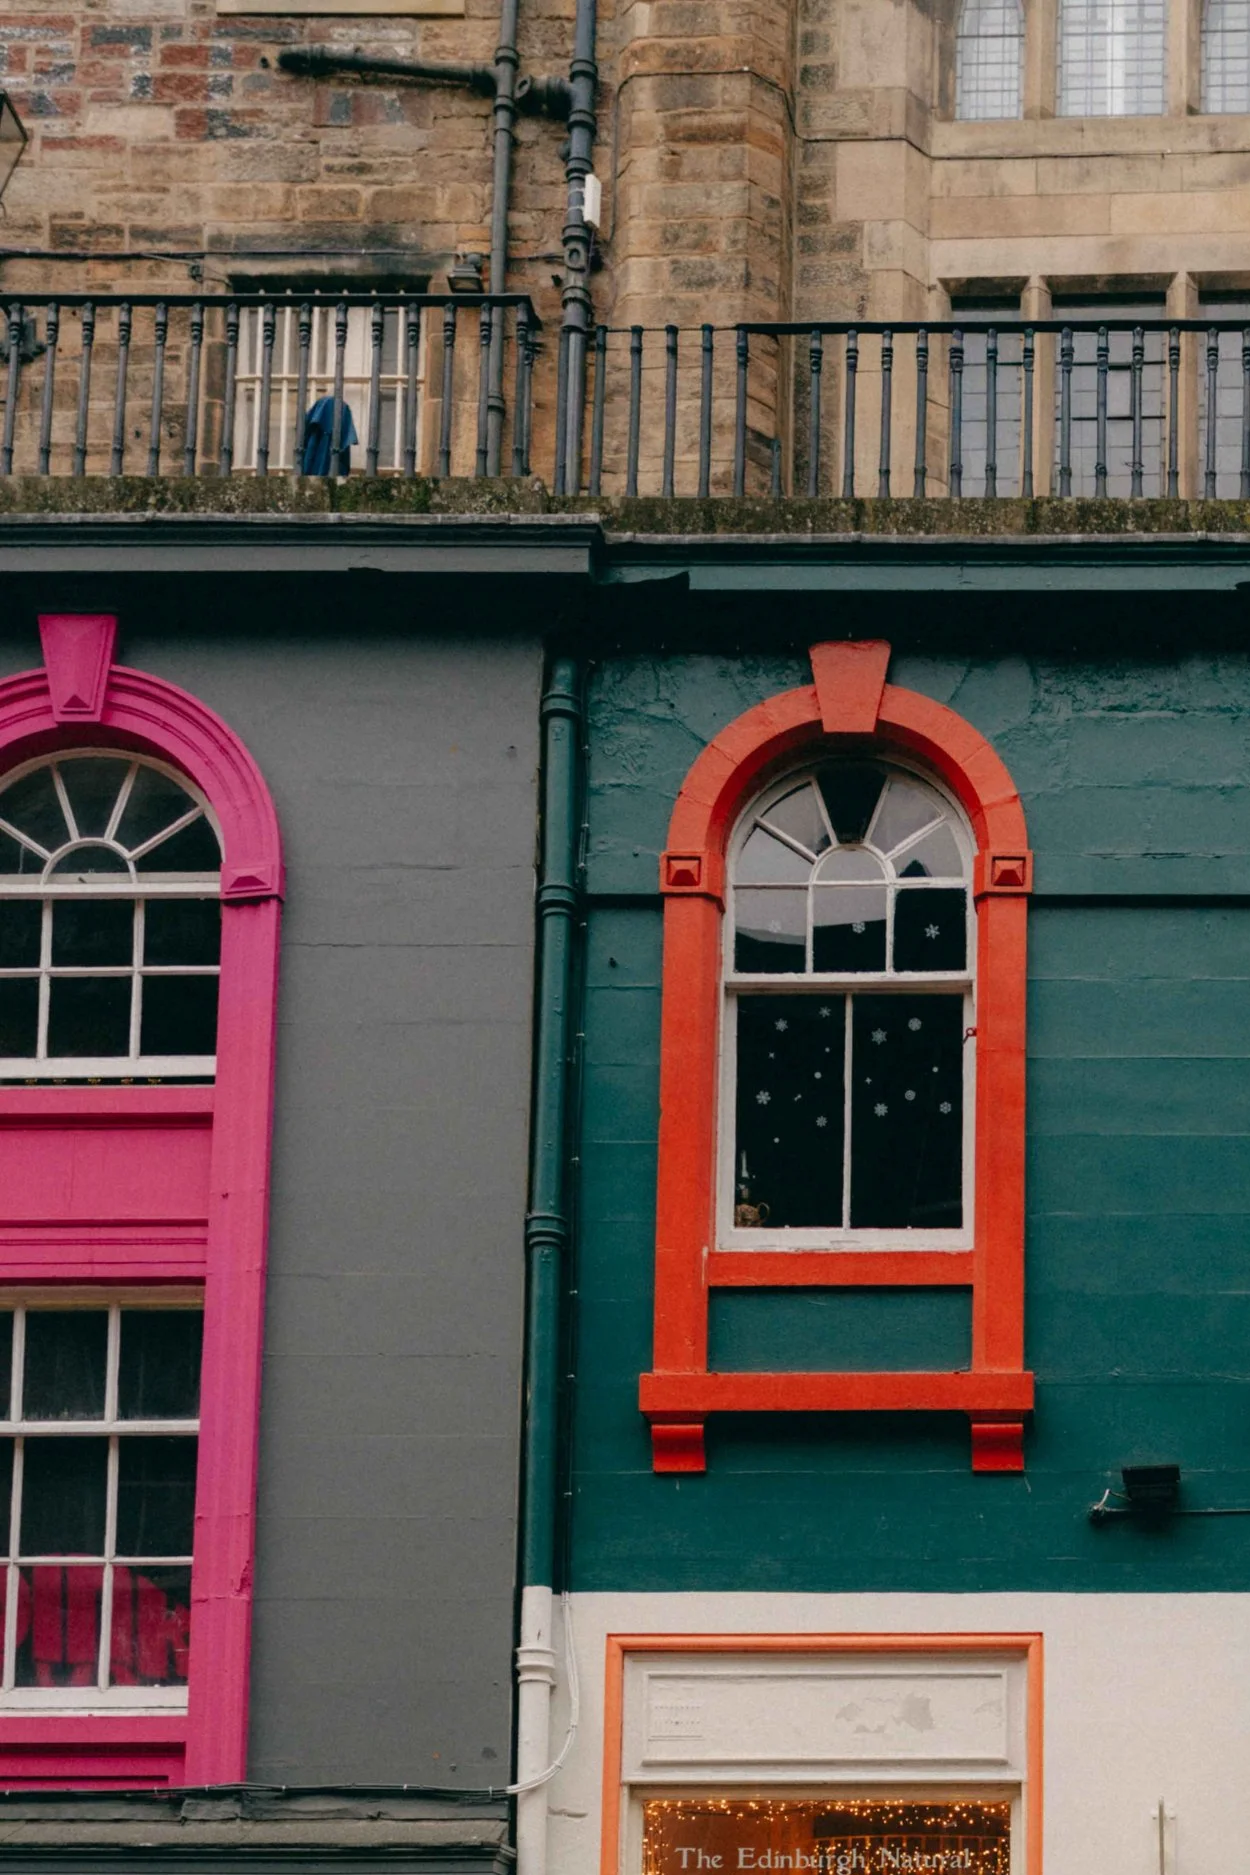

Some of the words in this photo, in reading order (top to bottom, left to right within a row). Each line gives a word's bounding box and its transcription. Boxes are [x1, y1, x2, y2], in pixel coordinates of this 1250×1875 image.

[674, 1847, 724, 1869] The
[737, 1847, 866, 1875] Edinburgh
[881, 1847, 970, 1869] Natural
